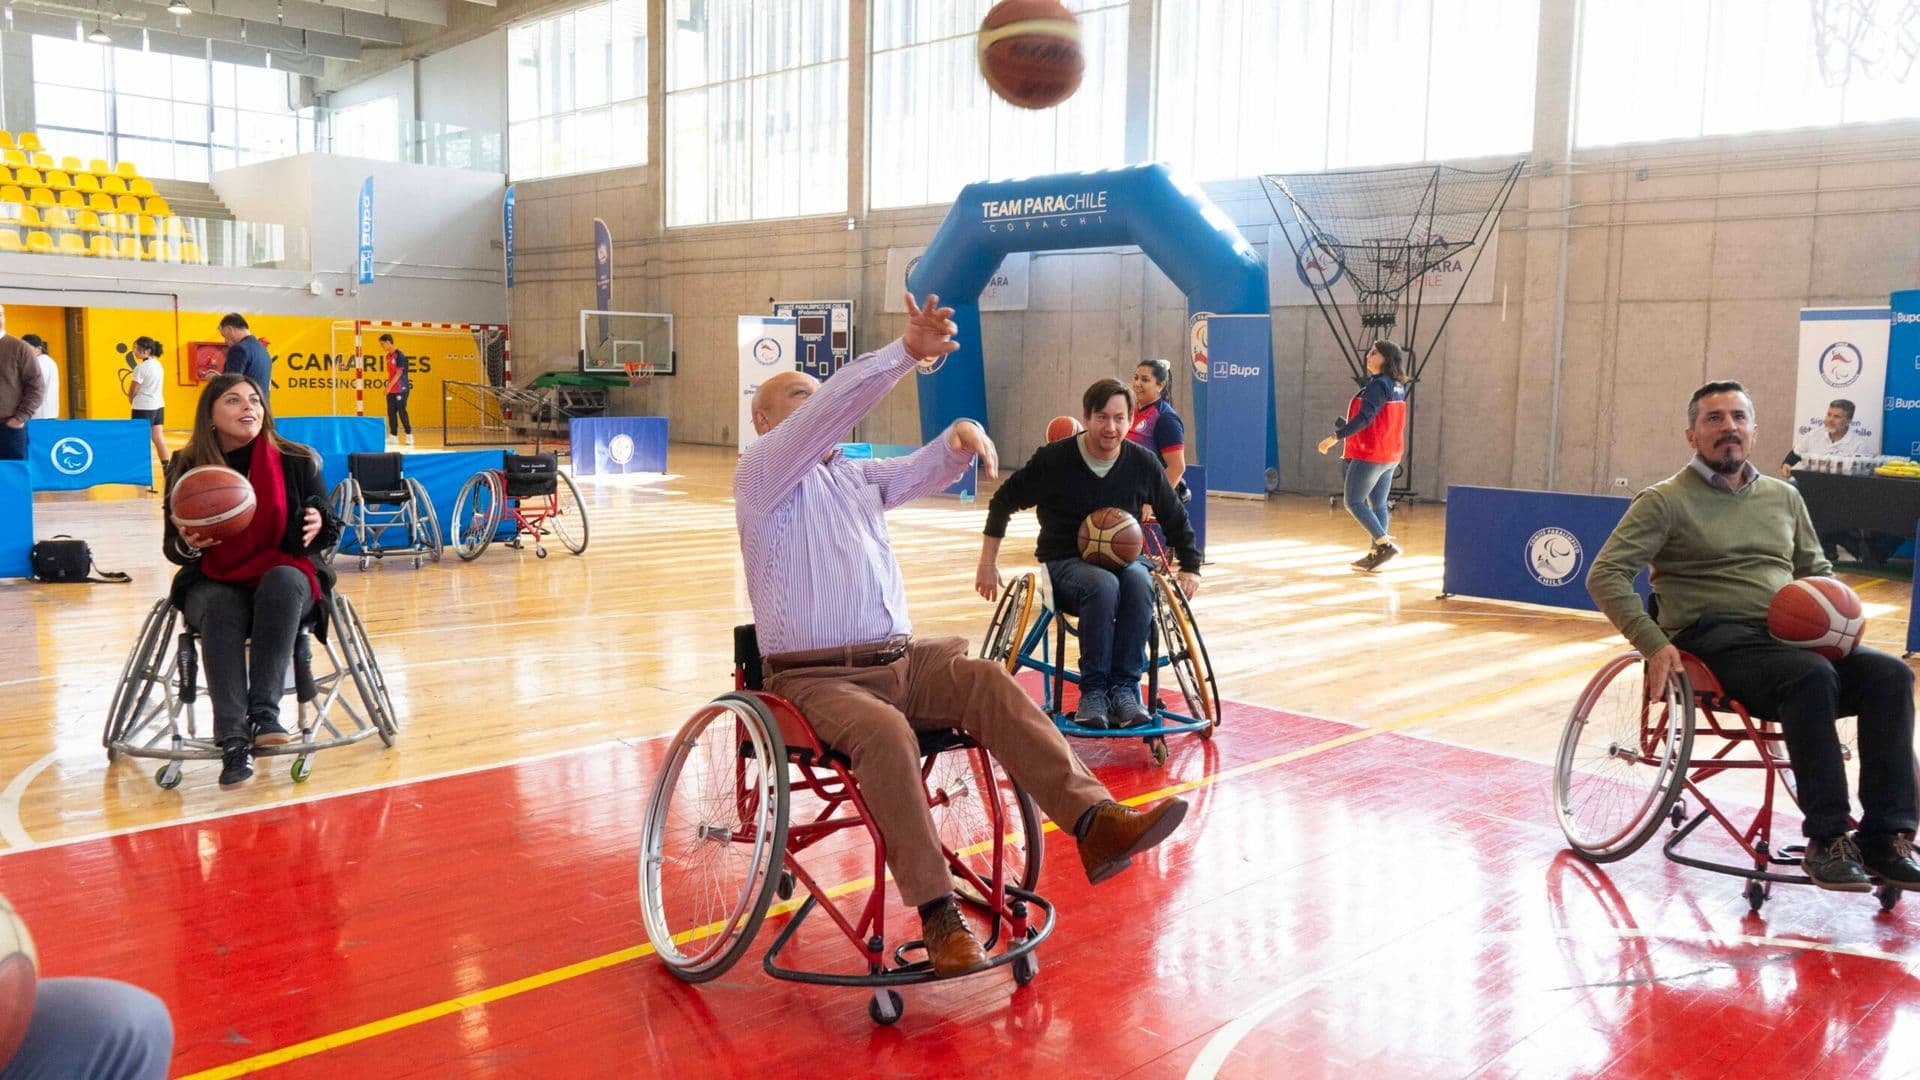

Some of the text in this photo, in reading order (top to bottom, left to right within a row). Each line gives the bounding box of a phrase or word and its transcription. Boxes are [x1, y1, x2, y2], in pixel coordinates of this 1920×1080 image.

[982, 191, 1107, 218] TEAM PARACHILE
[989, 216, 1102, 232] COPACHI
[990, 276, 1009, 287] ARA
[287, 352, 431, 373] CAMARIES
[1229, 363, 1260, 378] Bupa
[1538, 575, 1563, 585] CHILE
